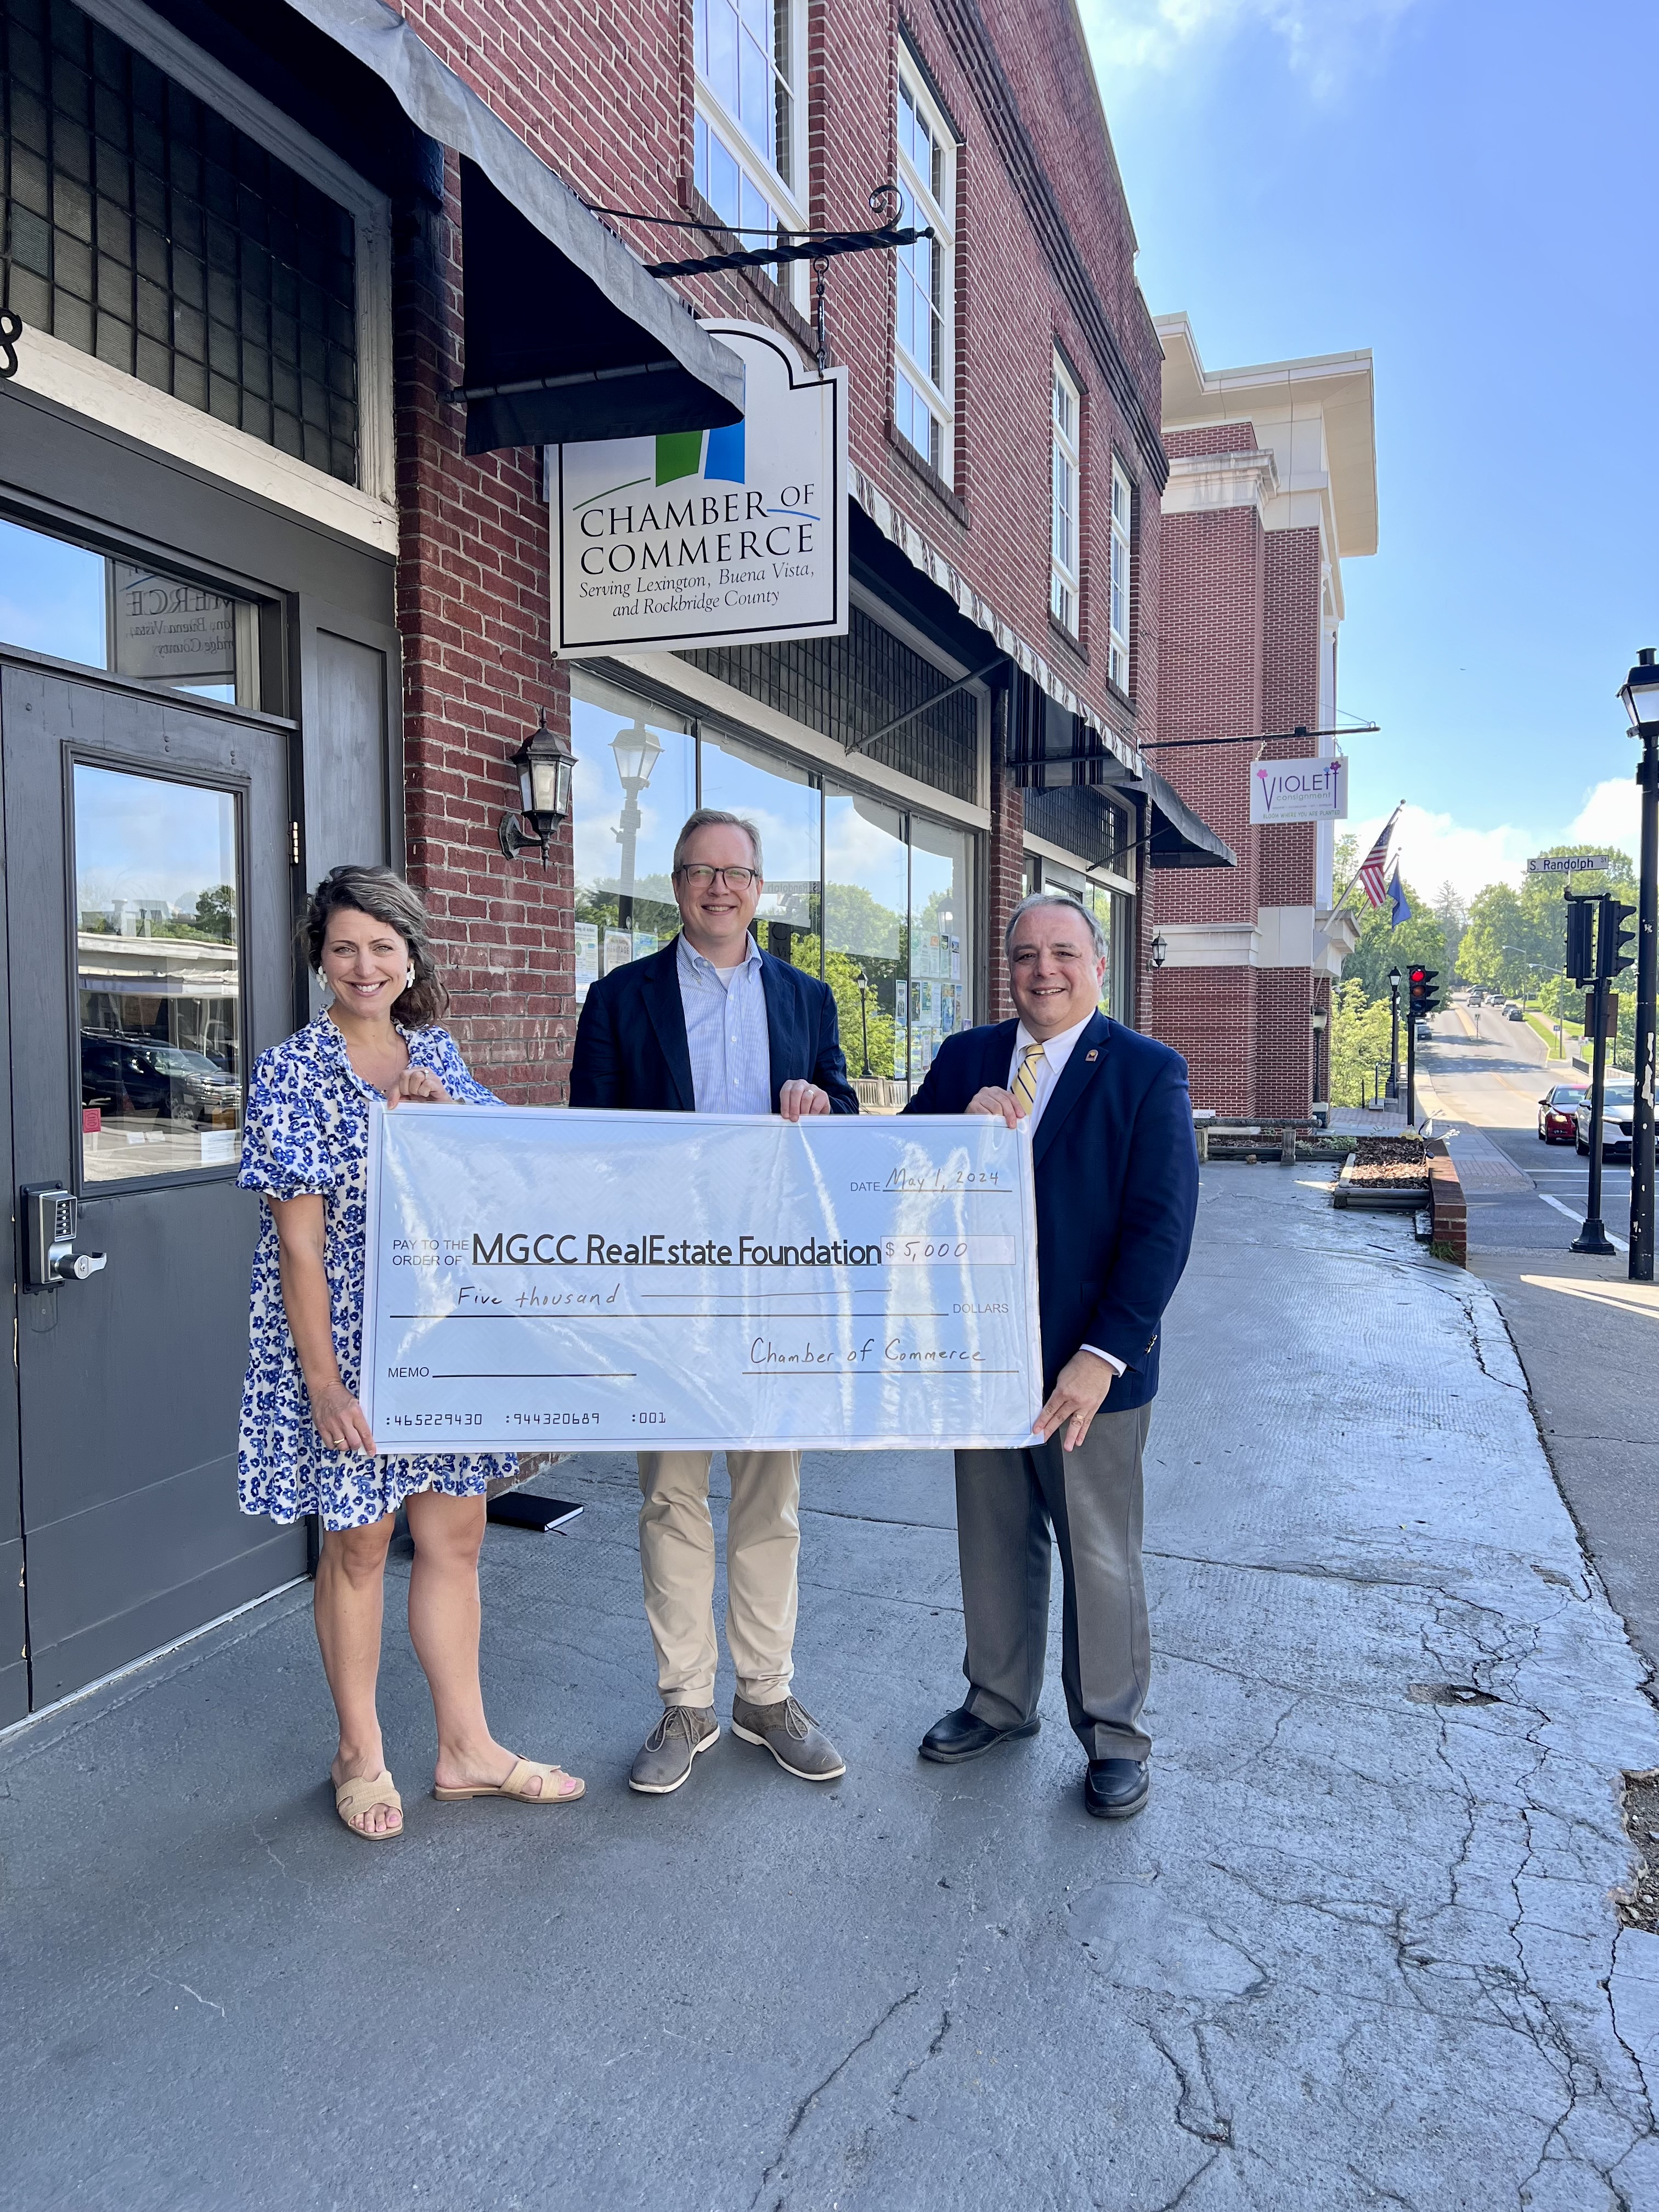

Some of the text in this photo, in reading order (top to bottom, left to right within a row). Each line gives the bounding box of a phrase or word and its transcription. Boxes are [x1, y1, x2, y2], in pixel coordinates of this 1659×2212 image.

[580, 483, 815, 538] CHAMBER OF
[580, 523, 814, 575] COMMERCE
[579, 562, 815, 599] Serving Lexington, Buena Vista,
[612, 589, 780, 617] and Rockbridge County
[1262, 771, 1339, 812] VIOLETT
[1276, 792, 1331, 801] consignment
[1530, 860, 1539, 871] S.
[1544, 859, 1593, 871] Randolph
[606, 945, 629, 955] HERITAGE
[850, 1181, 881, 1192] DATE
[885, 1167, 924, 1193] May
[955, 1171, 999, 1186] 2024
[392, 1255, 462, 1266] ORDER OF
[393, 1233, 882, 1265] PAY TO THE MGCC RealEstate Foundation
[457, 1283, 620, 1307] Five thousand
[952, 1303, 1009, 1313] DOLLARS
[751, 1337, 986, 1364] Chamber of Commerce
[388, 1367, 430, 1378] MEMO
